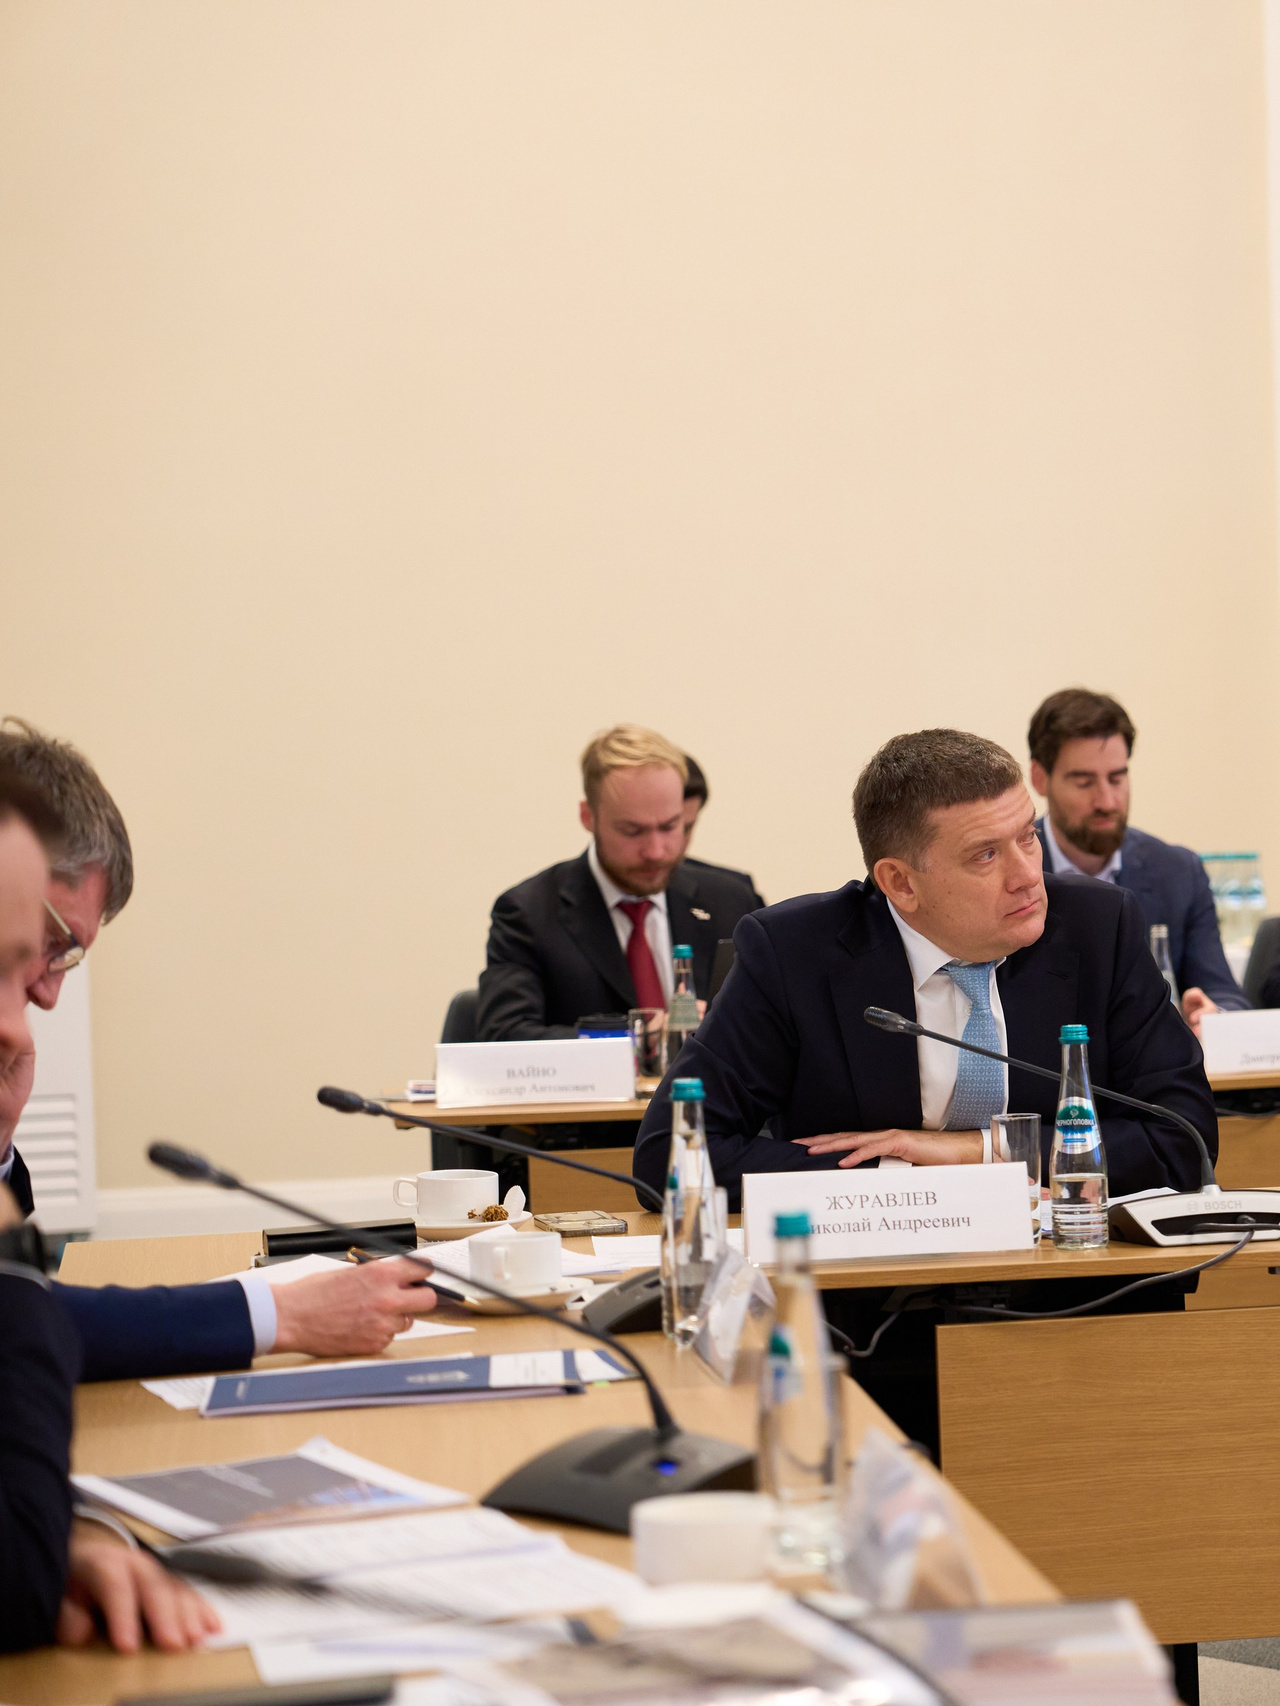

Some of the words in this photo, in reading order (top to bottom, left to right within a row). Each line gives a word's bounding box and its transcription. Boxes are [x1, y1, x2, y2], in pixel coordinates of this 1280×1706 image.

[506, 1065, 557, 1080] ВАЙНО
[825, 1190, 938, 1210] ЖУРАВЛЕВ
[1203, 1200, 1242, 1211] BOSCH
[810, 1218, 872, 1235] иколай
[877, 1215, 972, 1233] Андреевич
